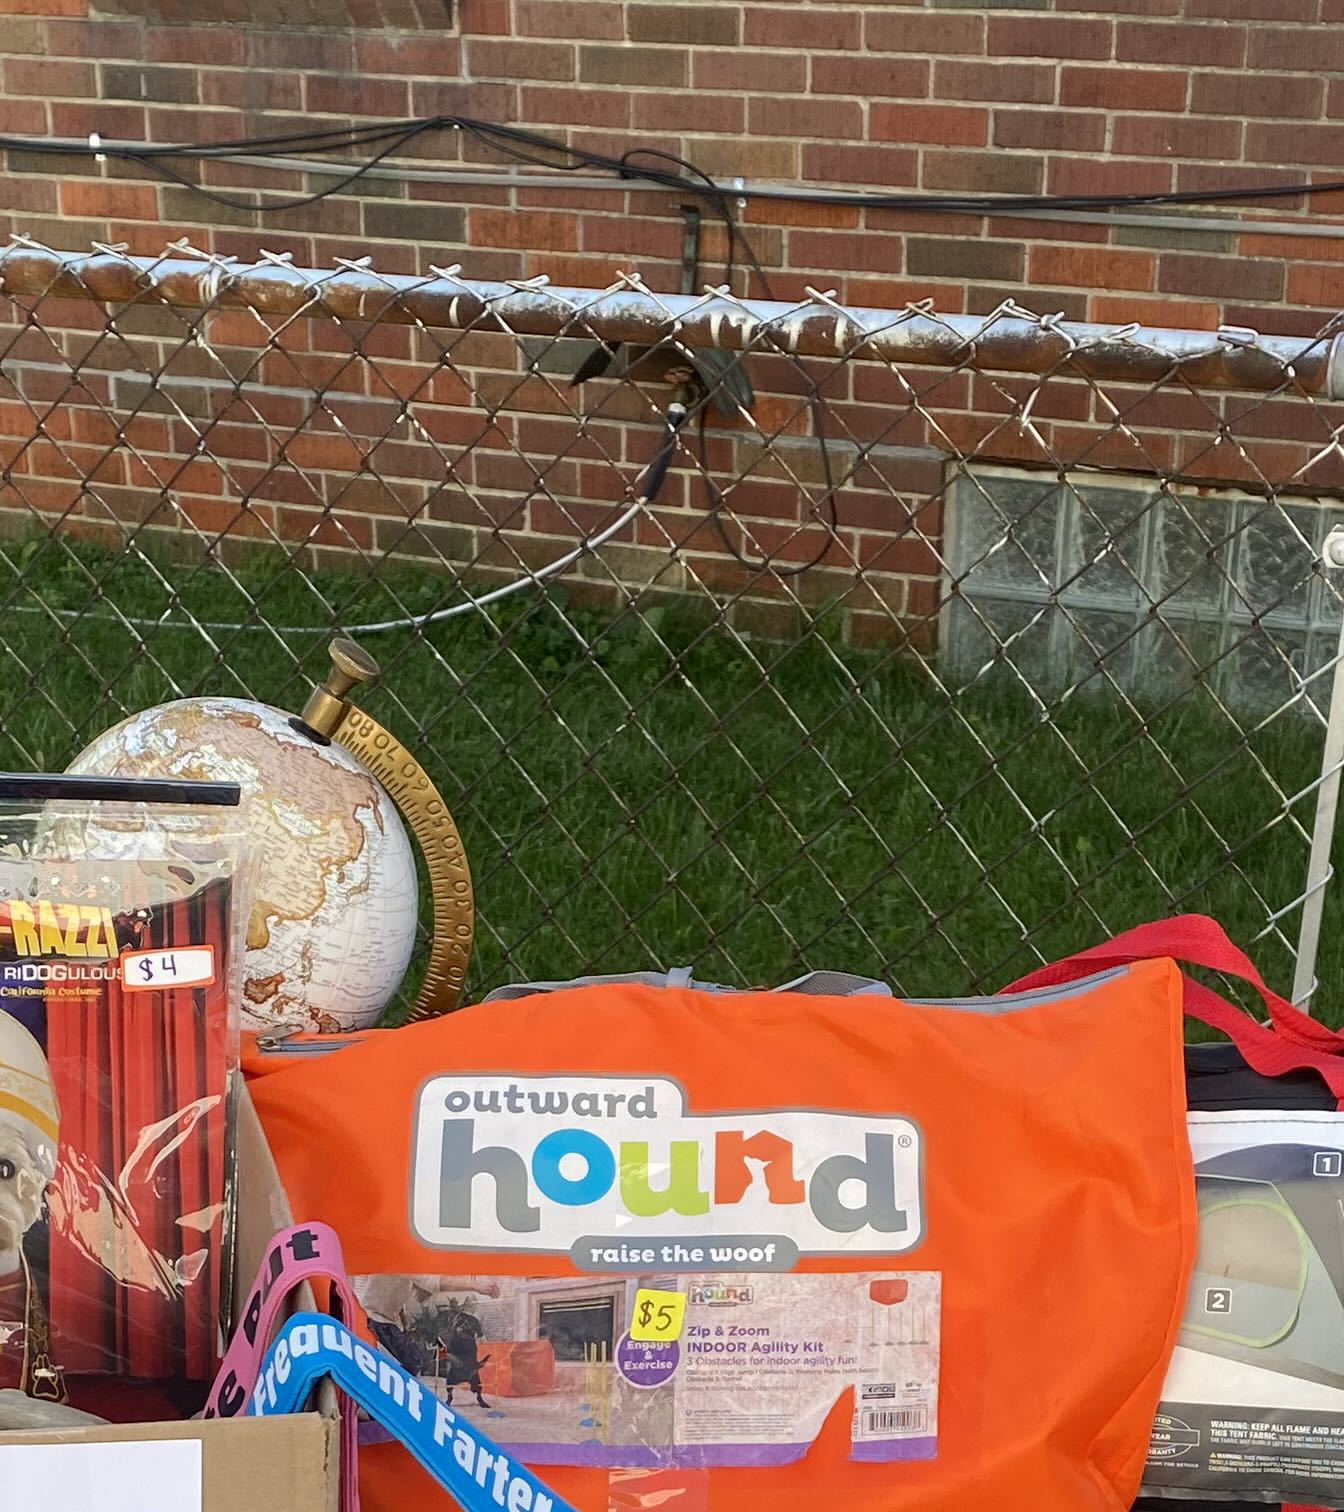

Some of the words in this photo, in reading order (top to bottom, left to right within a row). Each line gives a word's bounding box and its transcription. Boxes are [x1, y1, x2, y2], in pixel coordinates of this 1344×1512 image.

[374, 733, 399, 761] 70
[401, 762, 429, 790] 60
[426, 800, 453, 828] 50
[442, 835, 465, 871] 40
[452, 923, 472, 957] 20
[138, 954, 178, 983] $4
[447, 965, 465, 991] 10
[444, 1083, 658, 1121] outward
[1322, 1157, 1332, 1172] 1
[438, 1118, 909, 1235] hound
[590, 1245, 657, 1265] raise
[660, 1243, 706, 1264] the
[709, 1243, 777, 1264] woof
[1212, 1293, 1225, 1309] 2
[638, 1299, 676, 1332] $5
[687, 1326, 711, 1338] Zip
[715, 1326, 724, 1337] &
[728, 1326, 770, 1337] Zoom
[626, 1340, 672, 1351] Engage
[644, 1350, 654, 1360] &
[687, 1342, 747, 1353] INDOOR
[750, 1341, 798, 1355] Agility
[802, 1341, 824, 1353] Kit
[624, 1361, 674, 1371] Exercise
[686, 1356, 694, 1365] 3
[696, 1356, 747, 1366] Obstacles
[748, 1356, 764, 1365] for
[766, 1356, 801, 1366] indoor
[803, 1355, 836, 1367] agility
[1210, 1429, 1228, 1437] THIS
[1229, 1430, 1248, 1438] TENT
[1249, 1431, 1277, 1440] FABRIC.
[1211, 1420, 1250, 1430] WARNING:
[1251, 1422, 1270, 1431] KEEP
[1271, 1424, 1285, 1432] ALL
[1286, 1425, 1311, 1434] FLAME
[1312, 1426, 1329, 1435] AND
